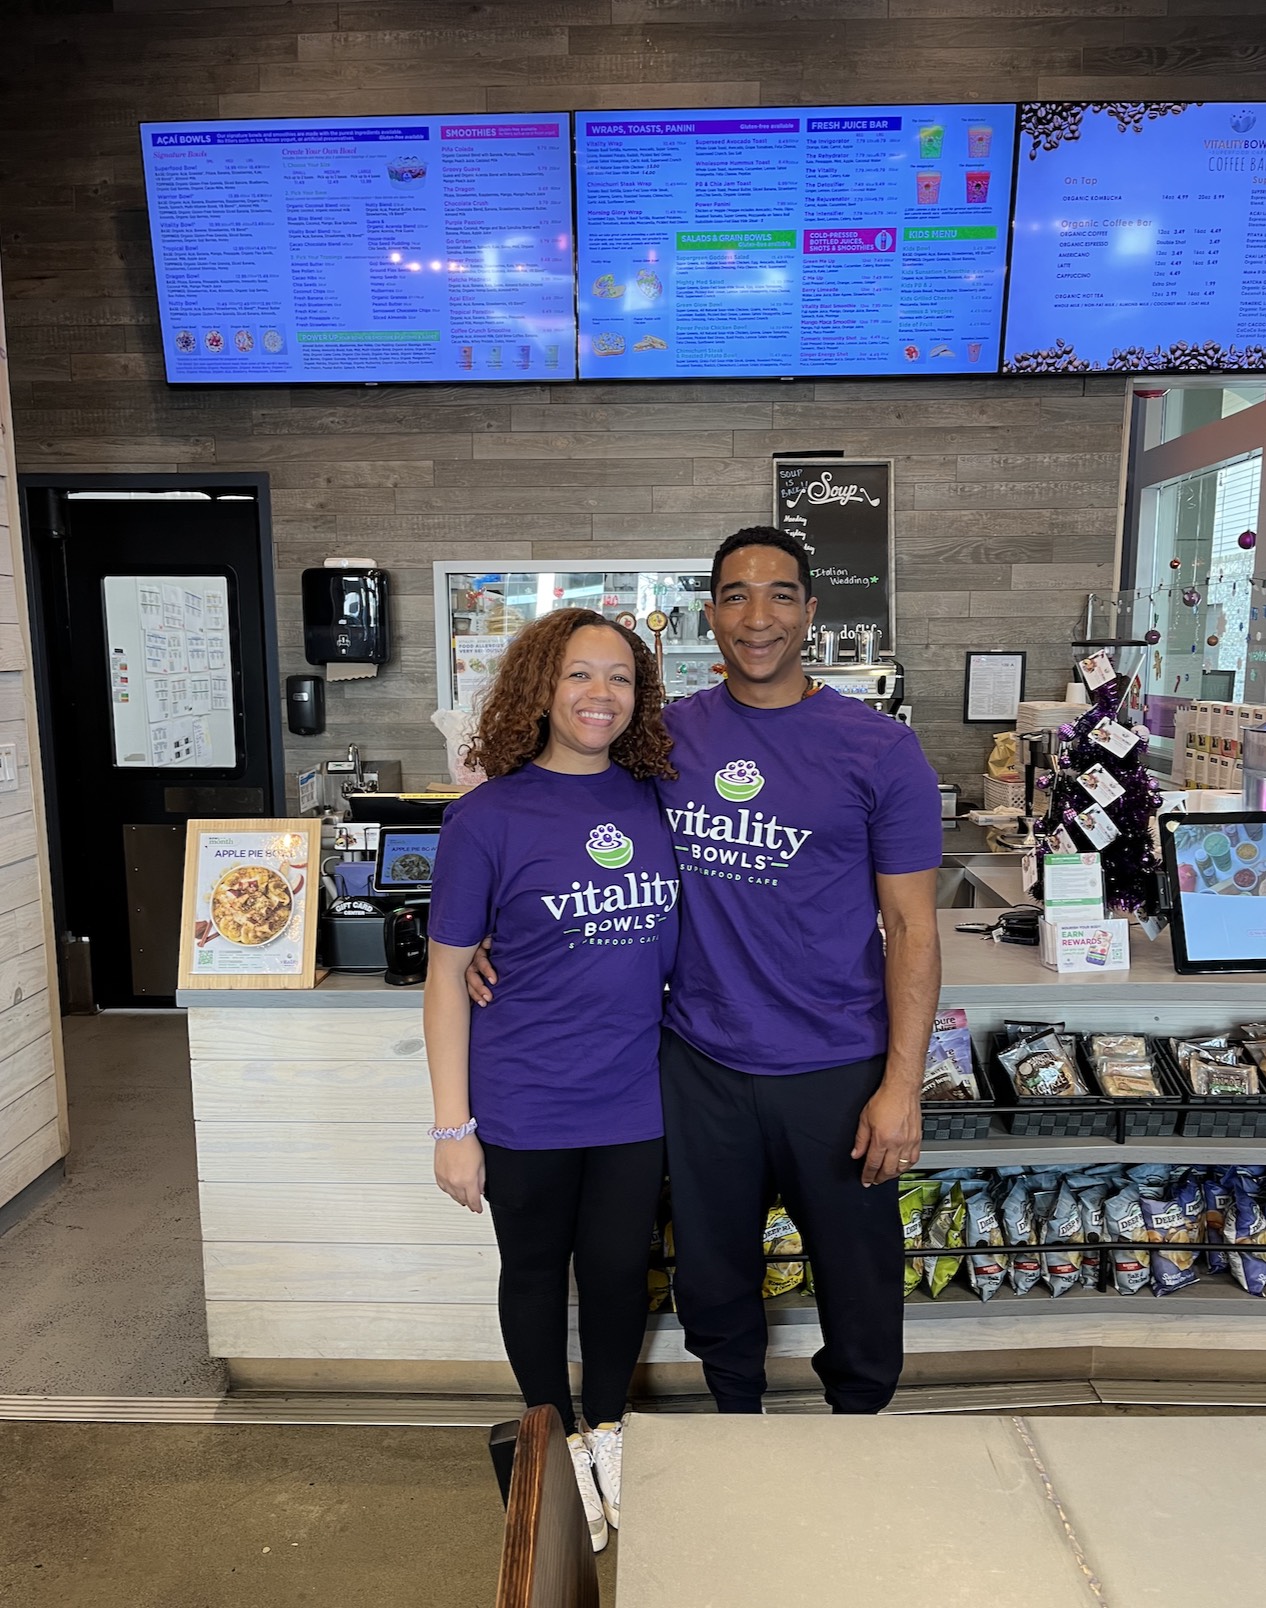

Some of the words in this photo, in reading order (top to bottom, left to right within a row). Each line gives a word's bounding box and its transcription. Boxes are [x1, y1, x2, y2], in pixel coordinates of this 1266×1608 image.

[592, 126, 626, 134] WRAPS,
[628, 124, 664, 134] TOASTS,
[665, 124, 695, 132] PANINI
[812, 122, 840, 130] FRESH
[842, 121, 868, 130] JUICE
[869, 120, 888, 129] BAR
[446, 128, 496, 138] SMOOTHIES
[180, 134, 212, 144] BOWLS
[153, 152, 186, 160] Signature
[1208, 156, 1246, 172] COFFEE
[1250, 156, 1266, 172] BA
[1064, 177, 1078, 185] On
[1081, 177, 1098, 186] Tap
[1061, 220, 1099, 230] Organic
[1102, 218, 1134, 228] Coffee
[1136, 218, 1152, 227] Bar
[909, 230, 930, 239] KIDS
[932, 230, 958, 238] MENU
[840, 238, 864, 246] JUICES,
[780, 469, 803, 479] SOUP
[807, 471, 861, 505] Soup
[783, 515, 808, 526] Monday
[814, 567, 848, 577] Italian
[830, 576, 870, 588] Wedding
[665, 800, 812, 860] vitality
[214, 850, 246, 858] APPLE
[248, 850, 264, 858] PIE
[691, 843, 768, 870] BOWLS
[748, 874, 778, 887] CAFE
[541, 871, 680, 921] vitality
[335, 901, 352, 913] GIFT
[352, 901, 374, 913] CARD
[584, 914, 656, 938] BOWLS
[568, 937, 634, 950] SERFOOD
[1062, 938, 1102, 946] REWARDS
[934, 1017, 956, 1027] pure
